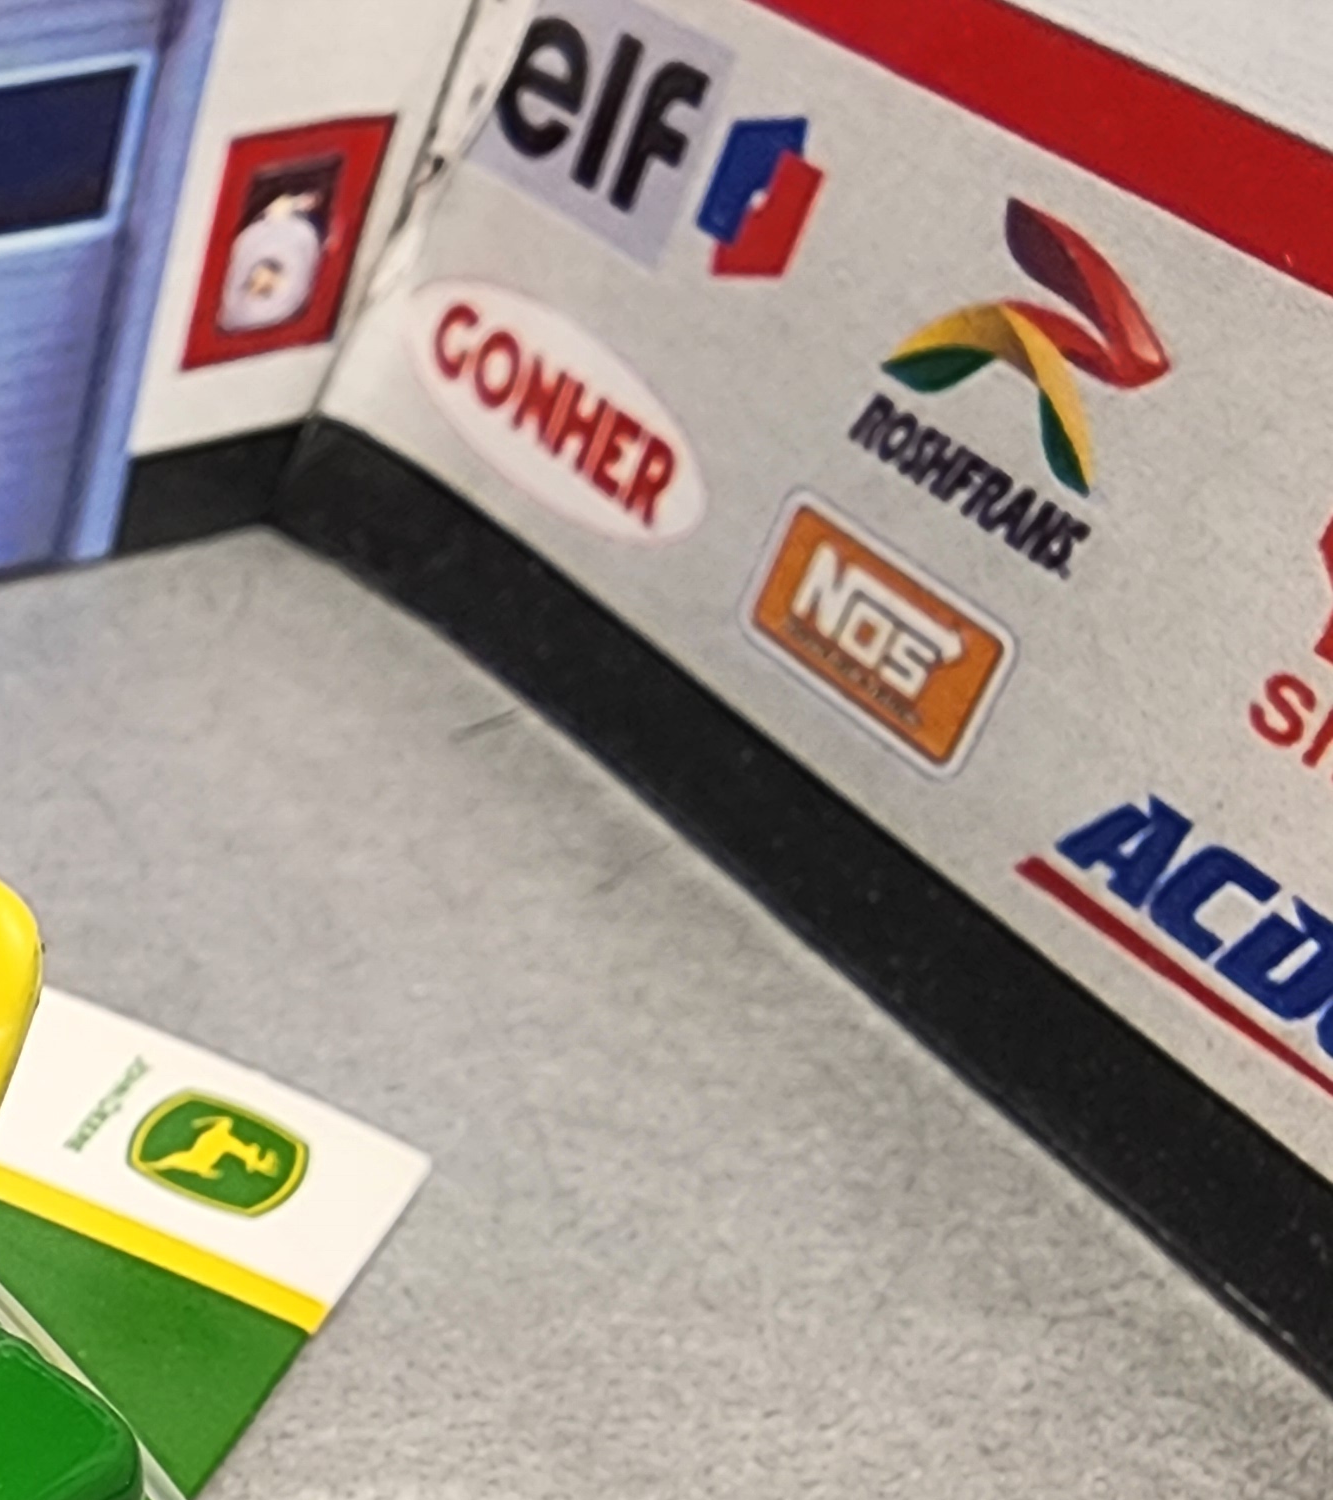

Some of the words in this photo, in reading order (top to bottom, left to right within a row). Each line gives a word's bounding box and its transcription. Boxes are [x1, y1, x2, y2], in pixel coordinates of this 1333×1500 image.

[497, 15, 711, 213] elf
[790, 540, 963, 700] NOS
[1054, 793, 1333, 1058] ACD
